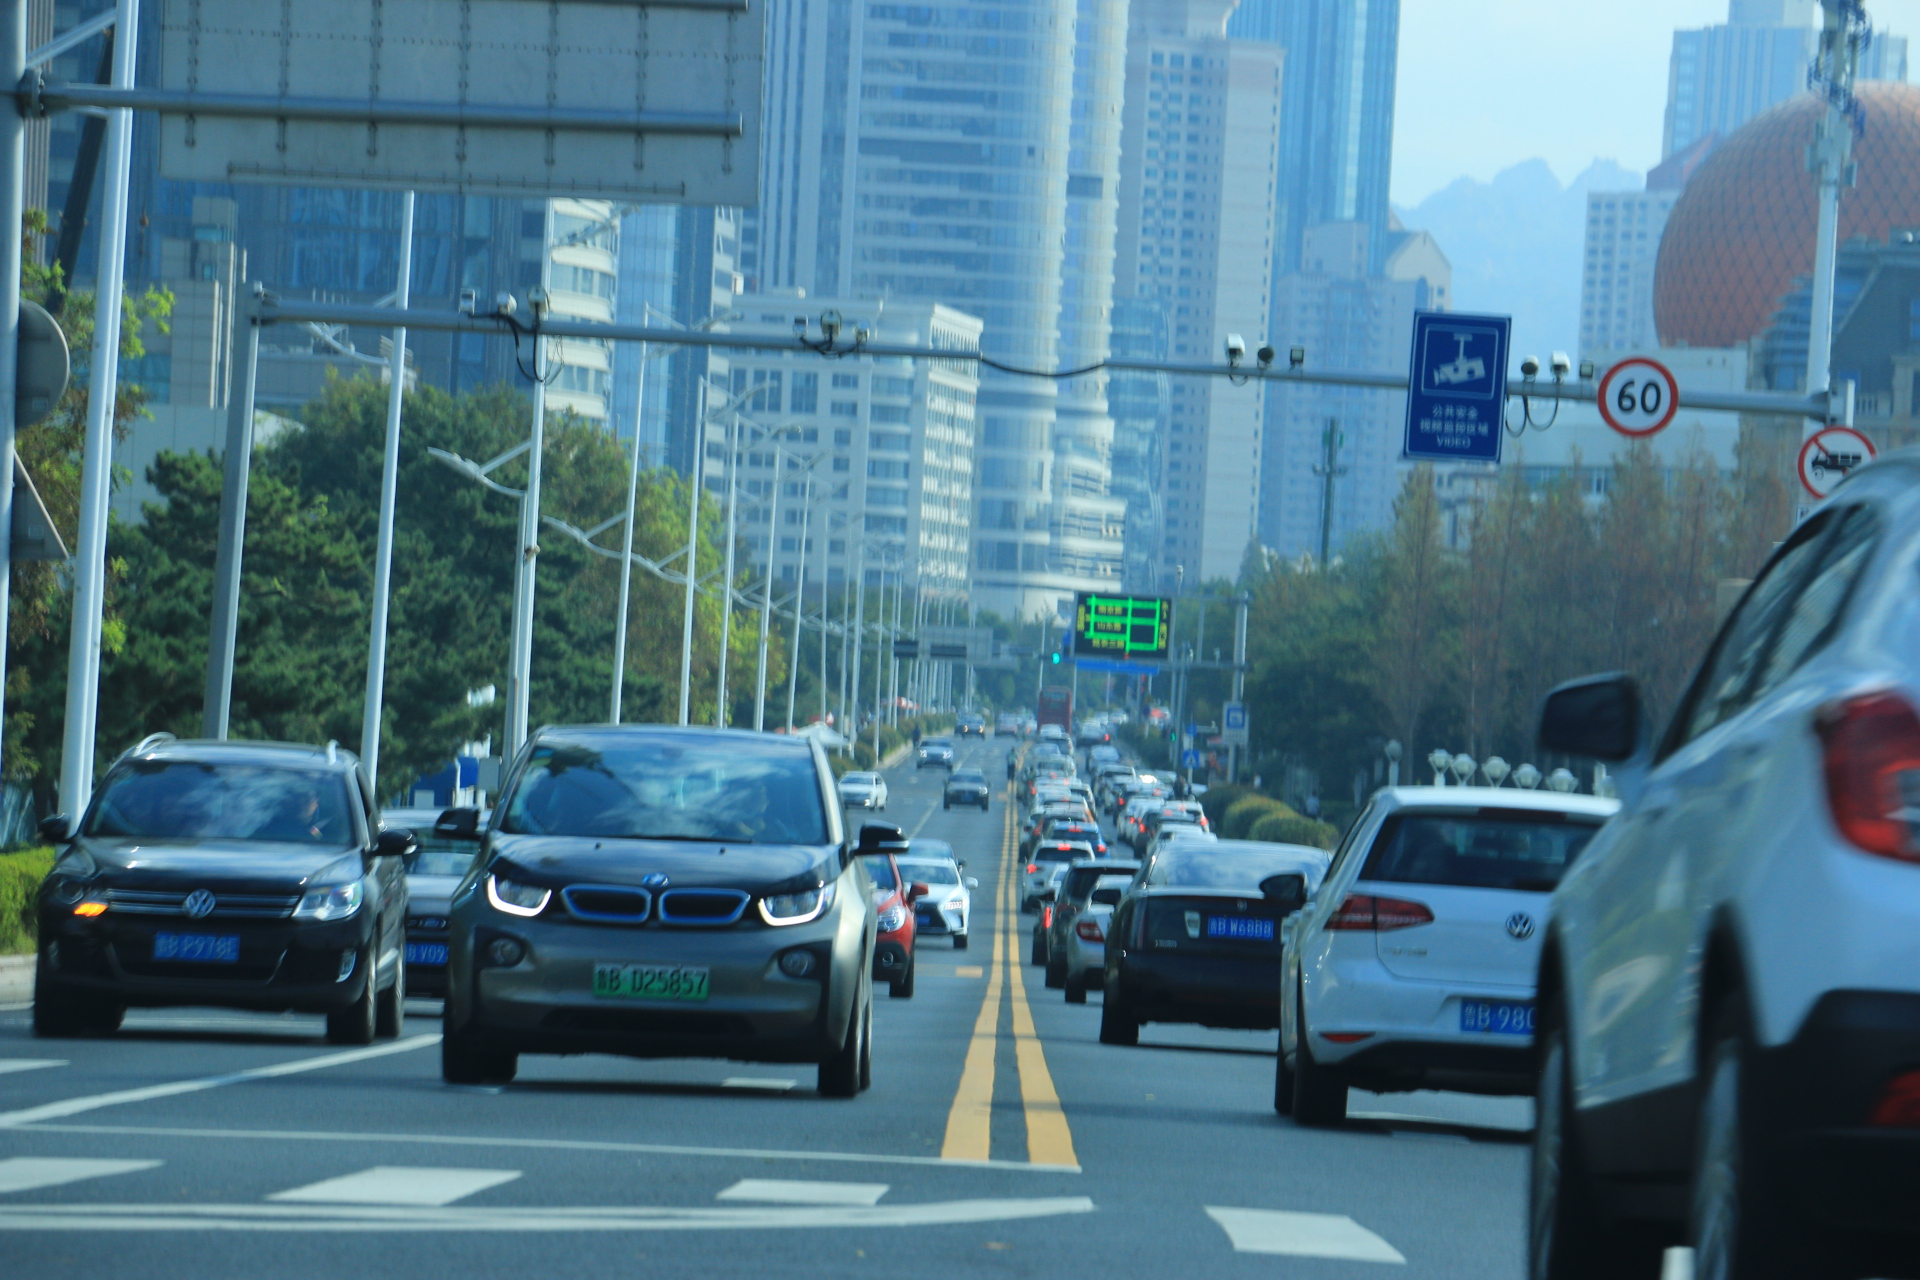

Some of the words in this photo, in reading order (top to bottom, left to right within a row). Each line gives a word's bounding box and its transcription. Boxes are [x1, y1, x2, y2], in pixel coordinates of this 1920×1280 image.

[1617, 379, 1662, 414] 60
[1436, 434, 1471, 449] VIDEO
[631, 968, 707, 995] D25857
